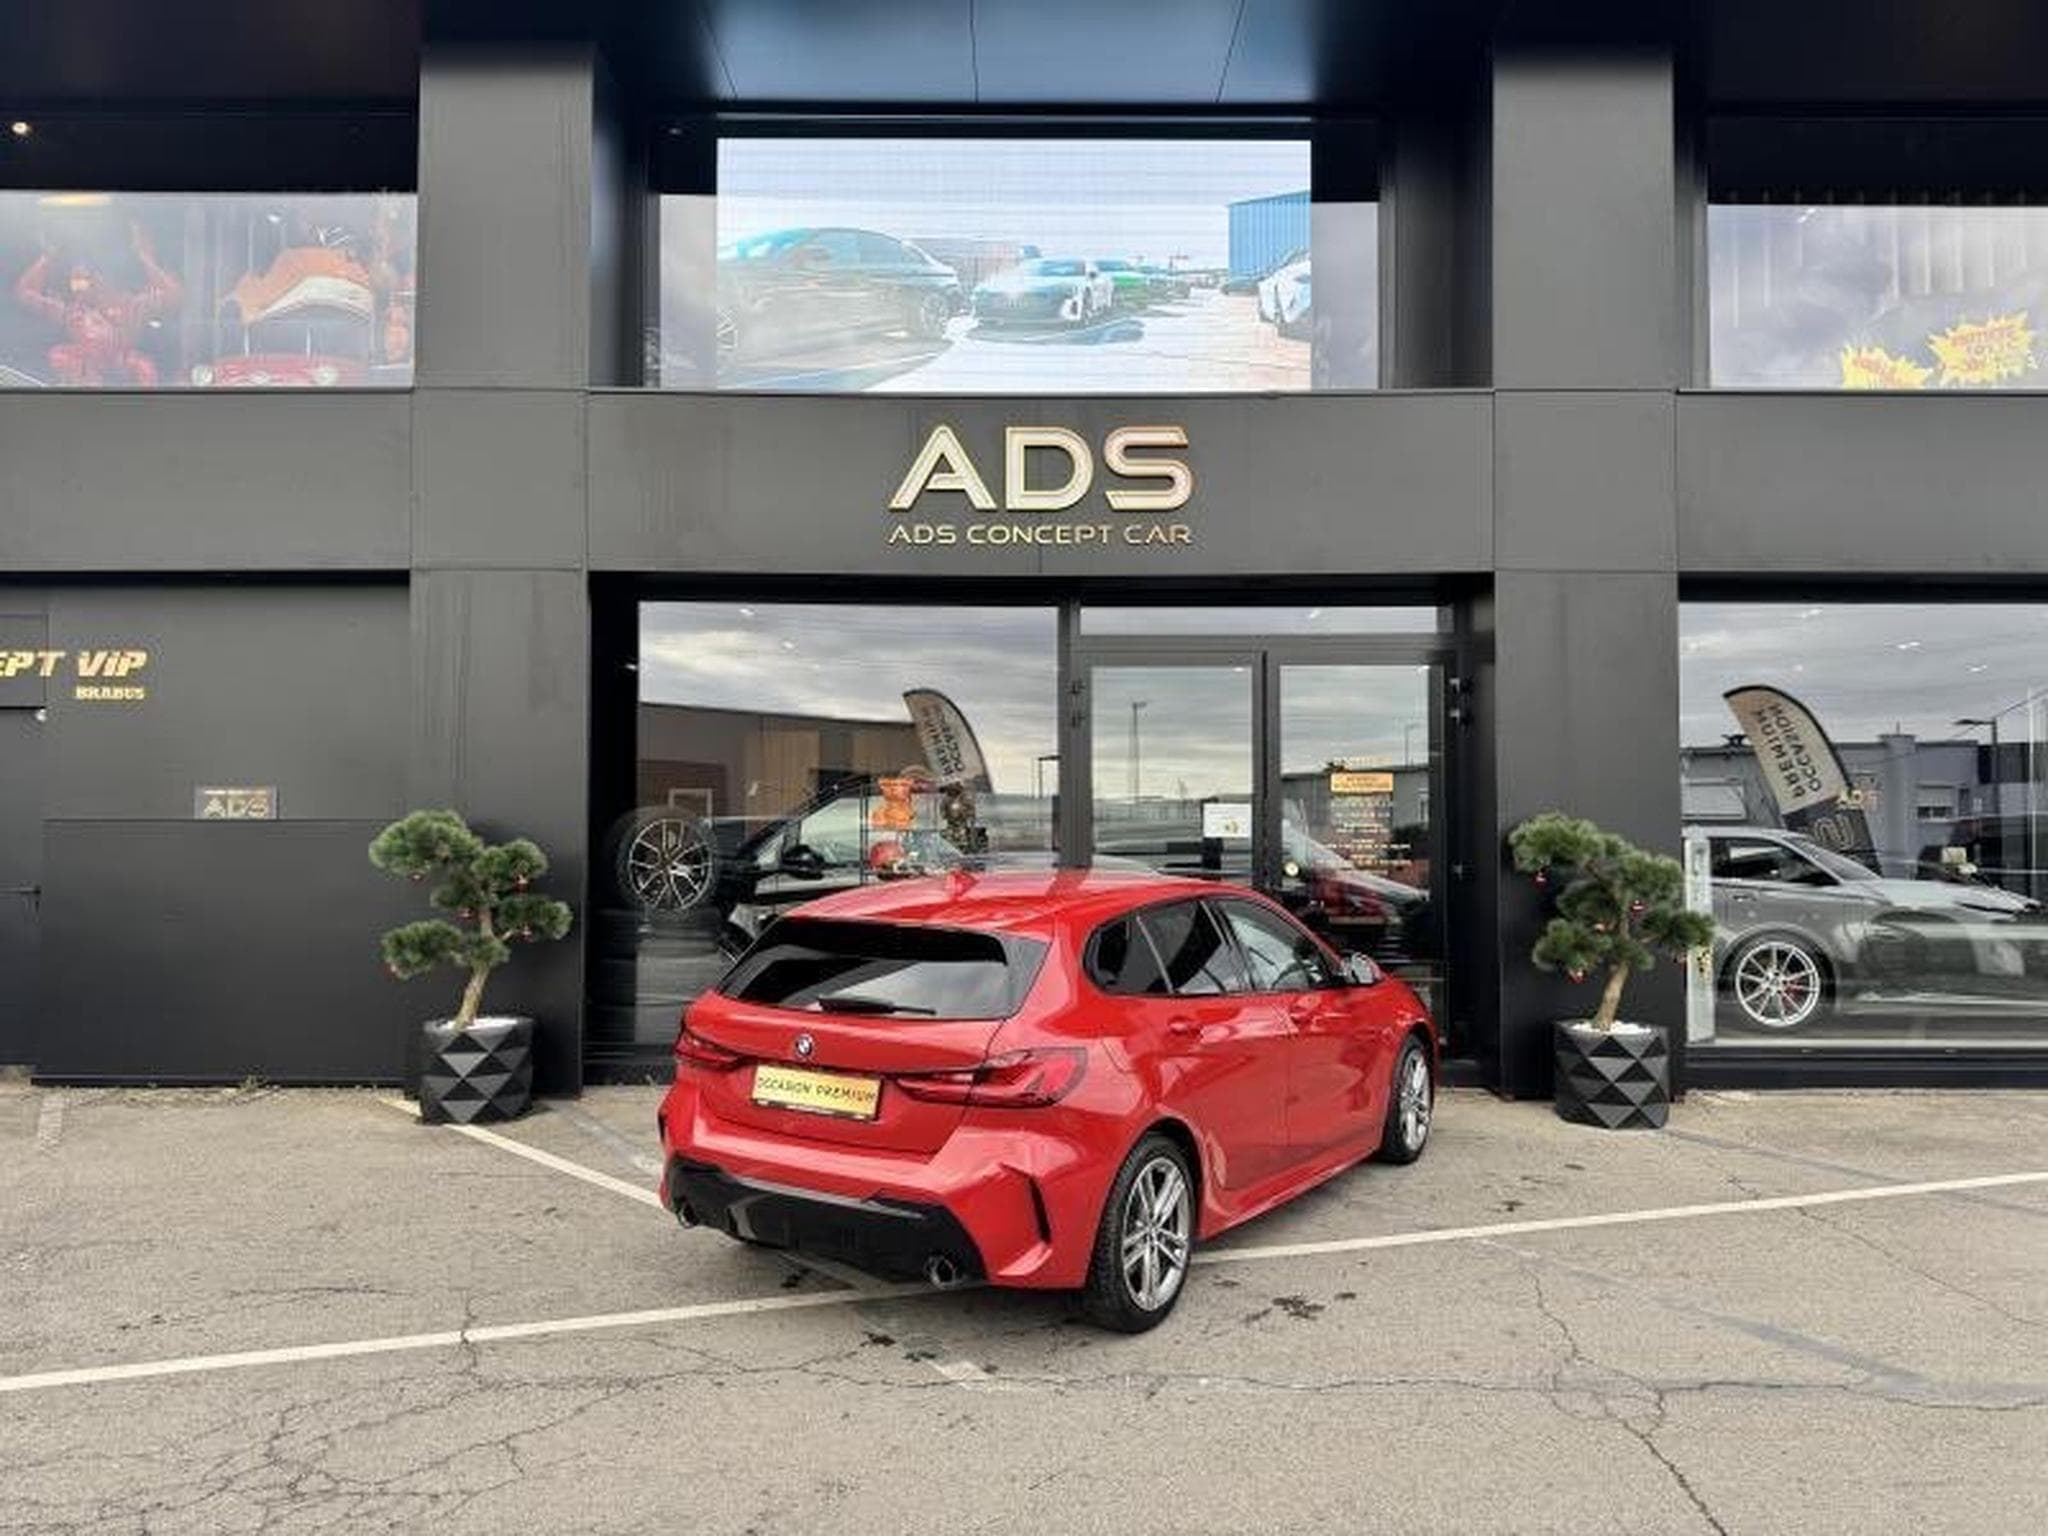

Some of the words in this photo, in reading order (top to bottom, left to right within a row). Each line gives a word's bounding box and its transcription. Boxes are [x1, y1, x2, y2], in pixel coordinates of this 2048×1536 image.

[888, 425, 1193, 511] ADS
[888, 523, 957, 545] ADS
[966, 523, 1113, 545] CONCEPT
[1123, 523, 1193, 545] CAR
[0, 651, 66, 677] PT
